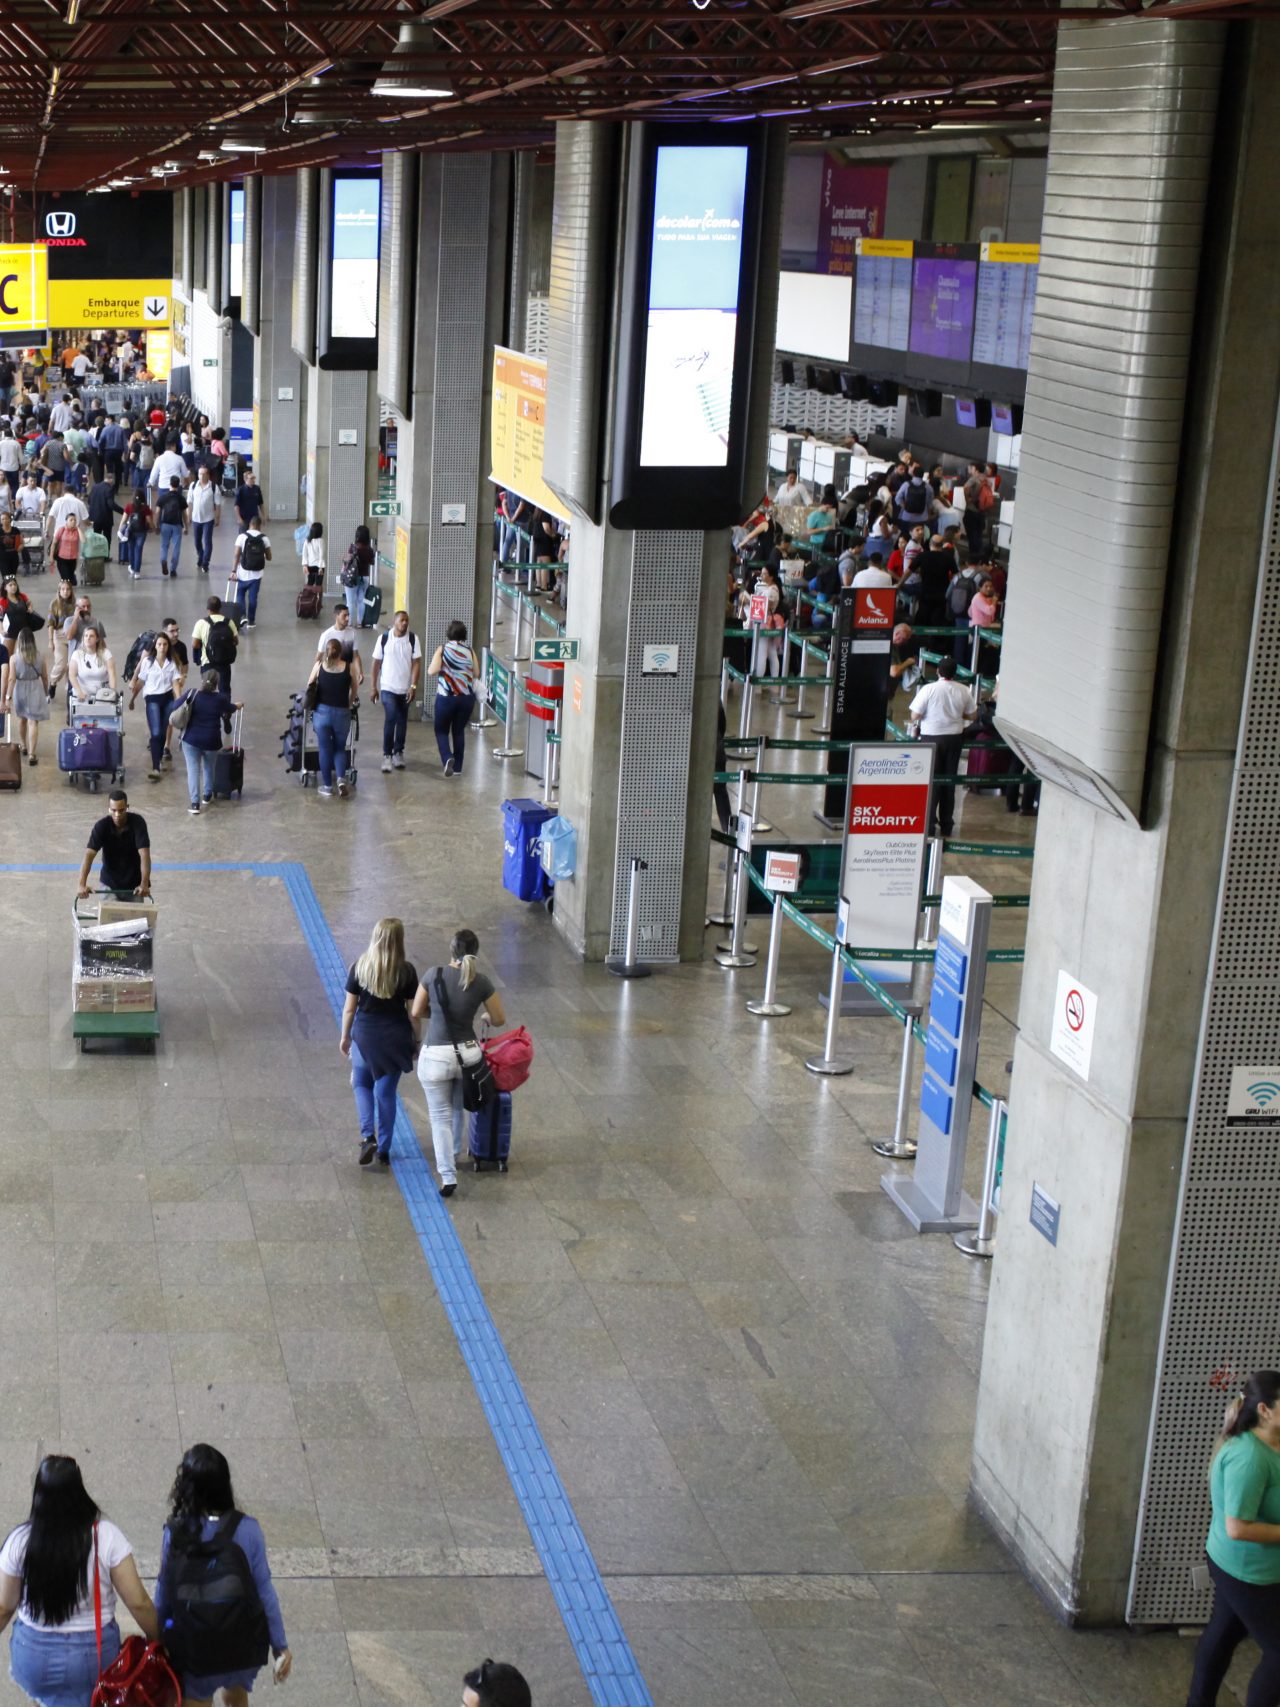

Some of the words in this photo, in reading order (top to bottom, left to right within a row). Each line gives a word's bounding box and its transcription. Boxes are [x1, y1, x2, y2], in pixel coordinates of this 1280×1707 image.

[88, 298, 140, 308] Embarque
[83, 309, 140, 320] Departures
[858, 616, 888, 625] Avianca
[841, 642, 850, 688] ALLIANCE
[837, 688, 846, 714] STAR
[858, 766, 906, 776] Argentinas
[854, 806, 882, 816] SKY
[852, 816, 918, 826] PRIORITY
[864, 849, 888, 857] SkyTeam
